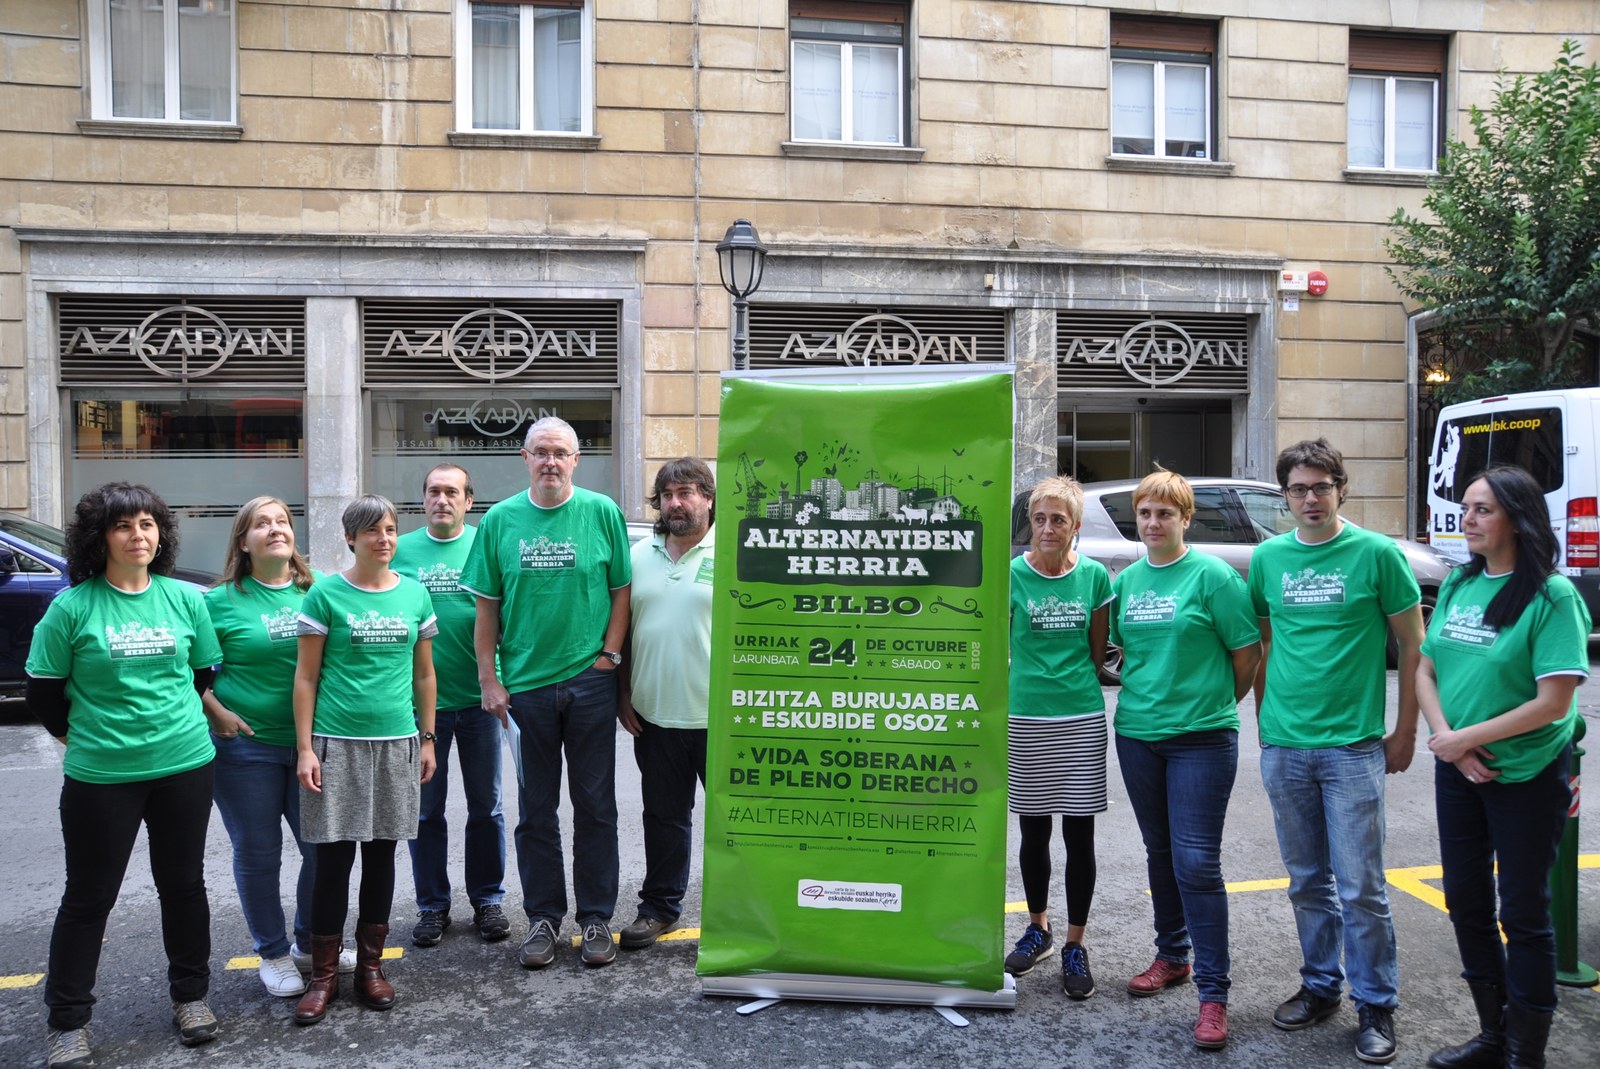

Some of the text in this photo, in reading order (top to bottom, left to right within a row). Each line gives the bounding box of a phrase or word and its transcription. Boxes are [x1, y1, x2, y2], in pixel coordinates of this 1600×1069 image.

[1463, 418, 1541, 435] www.lbk.coop
[744, 528, 975, 550] ALTERNATIBEN
[787, 556, 929, 577] HERRIA
[1284, 588, 1342, 597] ALTERNATIBEN
[1294, 595, 1331, 603] HERRIA
[793, 594, 923, 616] BILBO
[1125, 607, 1174, 616] ALTERNATIBEN
[270, 624, 298, 633] ALTERN
[1032, 615, 1085, 623] ALTERNATIBEN
[352, 629, 408, 637] ALTERNATIBEN
[111, 640, 174, 650] ALTERNATIBEN
[124, 648, 163, 656] HERRIA
[734, 635, 968, 666] URRIAK 24 DE OCTUBRE
[732, 654, 942, 670] LARUNBATA SÁBADO
[971, 641, 980, 670] 2015
[731, 690, 980, 711] BIZITZA BURUJABEA
[761, 711, 949, 732] ESKUBIDE OSOZ
[751, 747, 957, 773] VIDA SOBERANA
[729, 768, 979, 795] DE PLENO DERECHO
[727, 806, 977, 833] #ALTERNATIBENHERRIA
